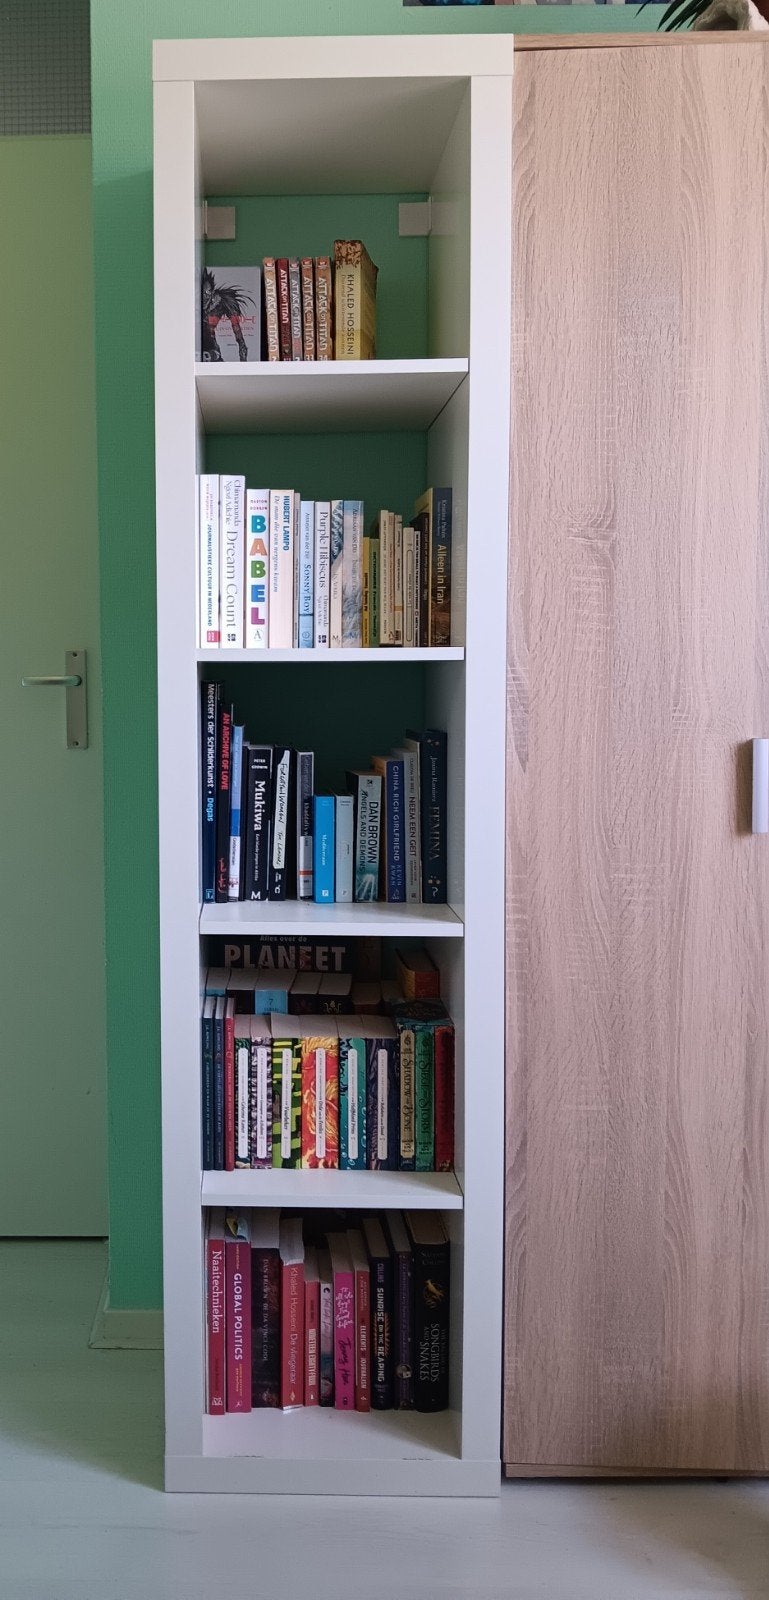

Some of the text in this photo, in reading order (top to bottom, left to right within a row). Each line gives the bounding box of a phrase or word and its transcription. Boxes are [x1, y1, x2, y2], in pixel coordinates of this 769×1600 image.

[265, 278, 276, 314] ATTACK
[292, 280, 300, 308] ATTACK
[304, 277, 313, 313] ATTACK
[318, 277, 327, 314] ATTACK
[346, 274, 354, 354] KHALED HOSSEINI
[269, 324, 278, 352] TITAN
[306, 322, 314, 350] TITAN
[319, 322, 328, 350] TITAN
[226, 531, 238, 578] Dream
[318, 512, 329, 588] Purple Hibiscus
[437, 544, 446, 574] Alleen
[250, 515, 268, 625] BABEL
[437, 576, 446, 584] in
[226, 584, 238, 627] Count
[303, 564, 312, 614] SONNY BOY
[437, 586, 446, 604] Iran
[222, 713, 230, 724] AN
[222, 760, 228, 769] OF
[206, 798, 214, 822] Degas
[254, 780, 265, 830] Mukiwa
[360, 790, 369, 819] ANGELS
[368, 802, 378, 864] DAN BROWN
[224, 944, 346, 971] PLANEET
[212, 1250, 223, 1333] Naaitechnieken
[290, 1268, 298, 1295] Khaled
[234, 1273, 243, 1360] GLOBAL POLITICS
[420, 1342, 430, 1380] SNAKES
[430, 1324, 441, 1382] SONGBIRDS
